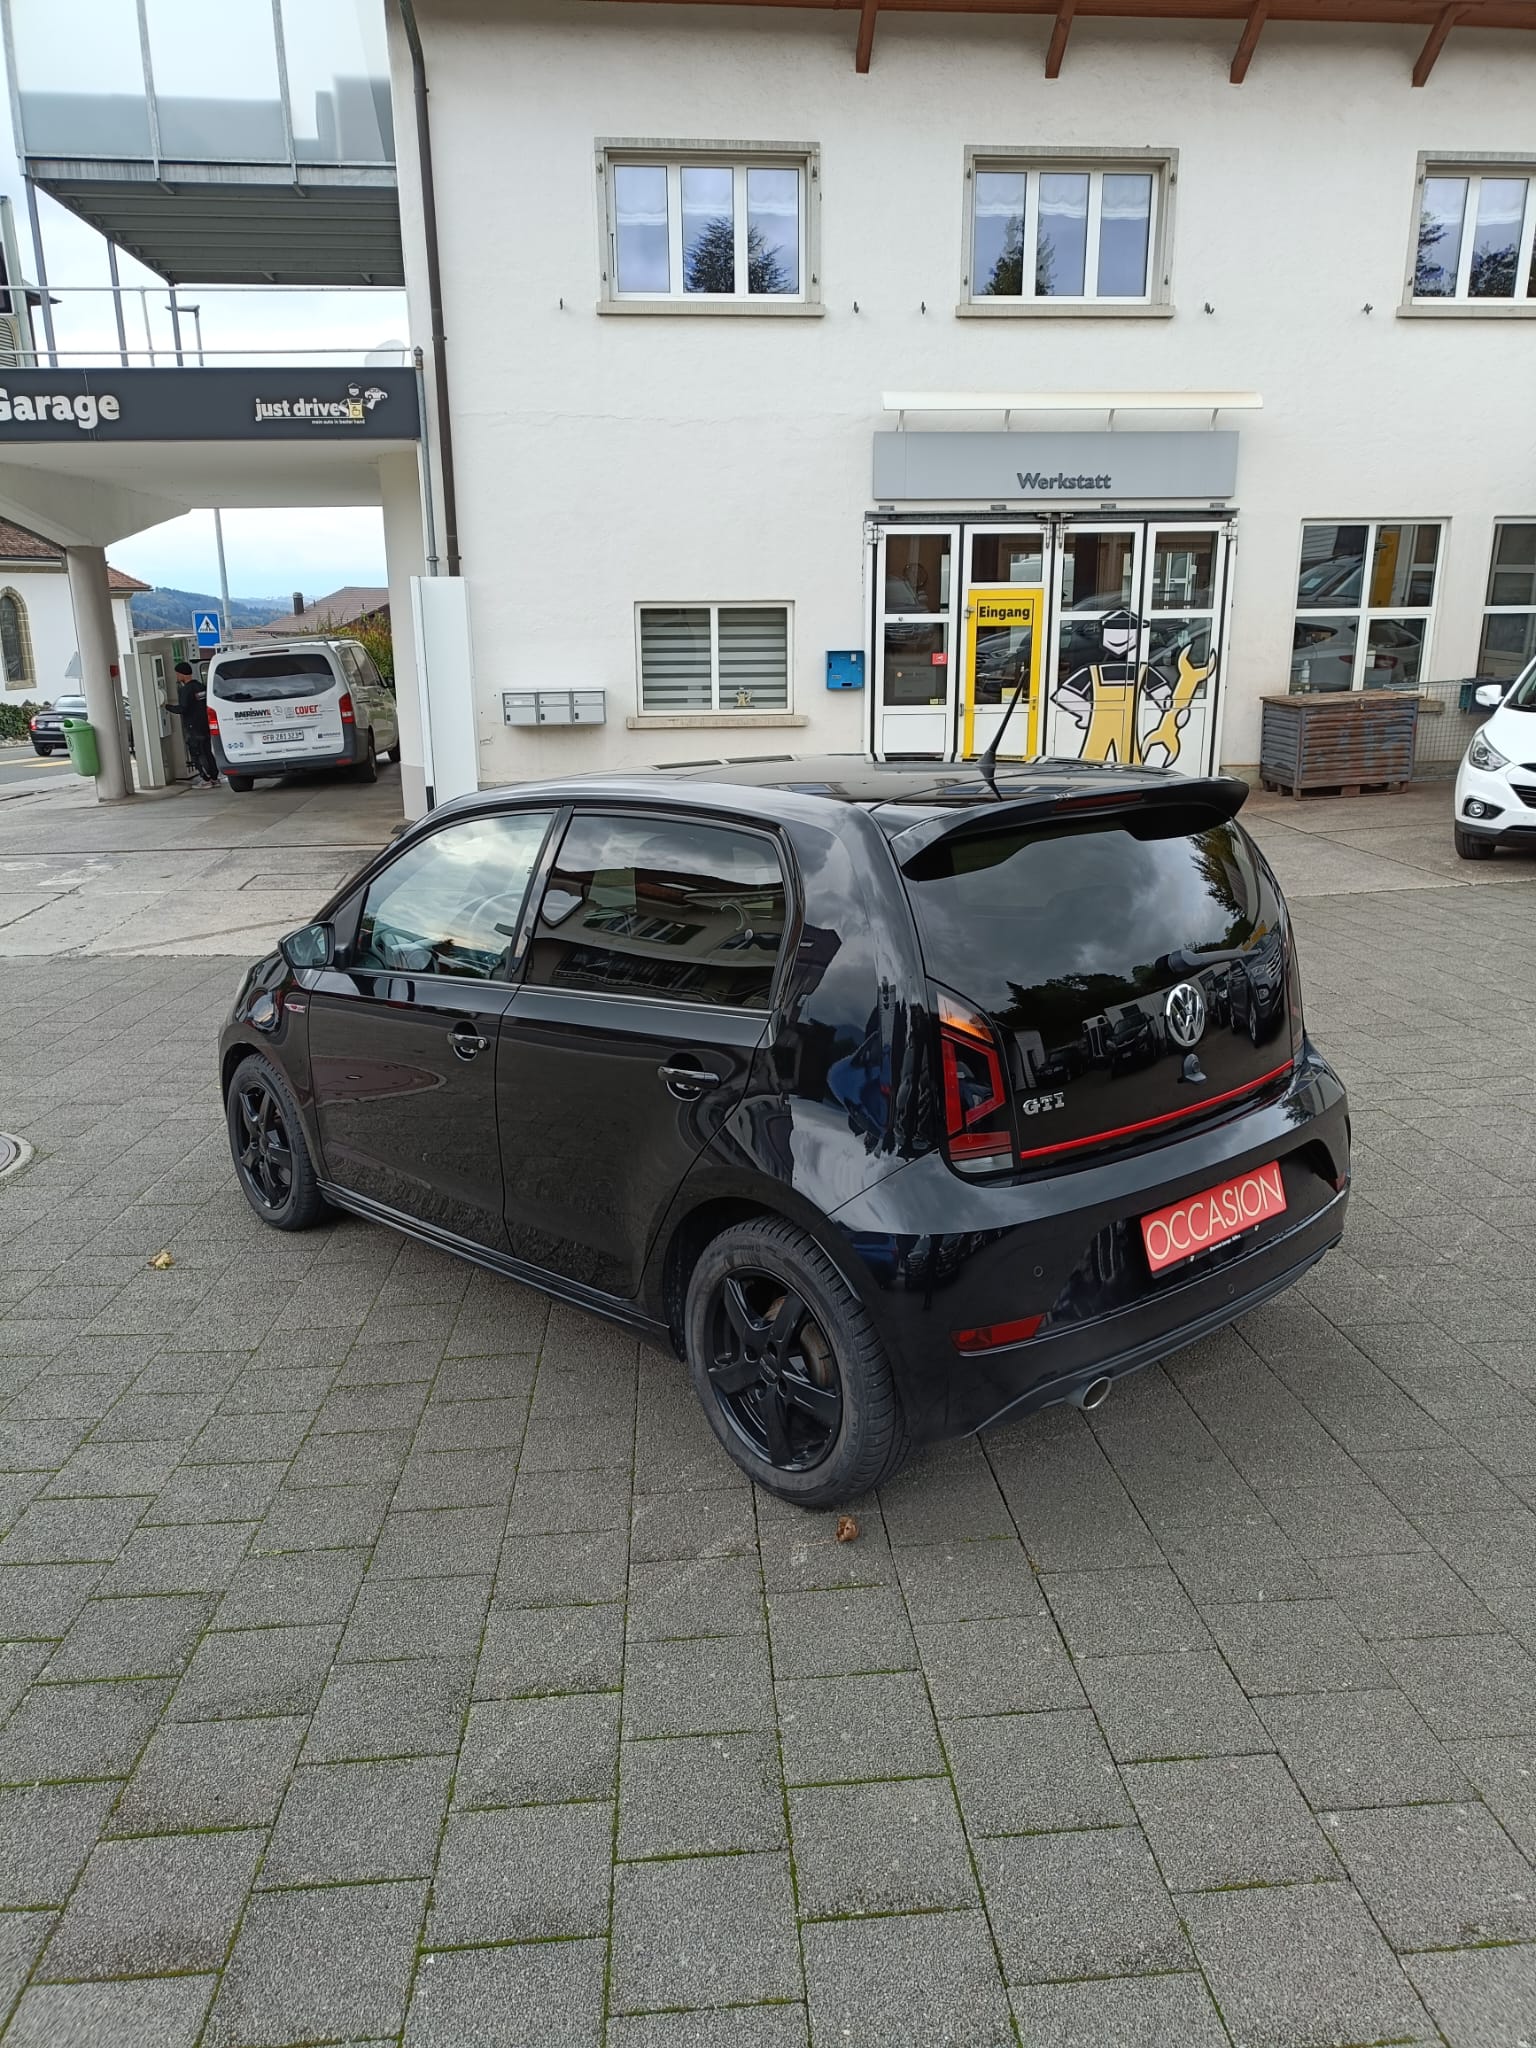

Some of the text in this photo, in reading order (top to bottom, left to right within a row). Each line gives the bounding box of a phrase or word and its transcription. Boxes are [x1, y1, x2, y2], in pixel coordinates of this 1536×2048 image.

[255, 398, 340, 421] just drive
[1016, 472, 1112, 489] Werkstatt
[979, 606, 1030, 620] Eingang
[1023, 1092, 1064, 1115] GTI
[1147, 1169, 1283, 1260] OCCASION
